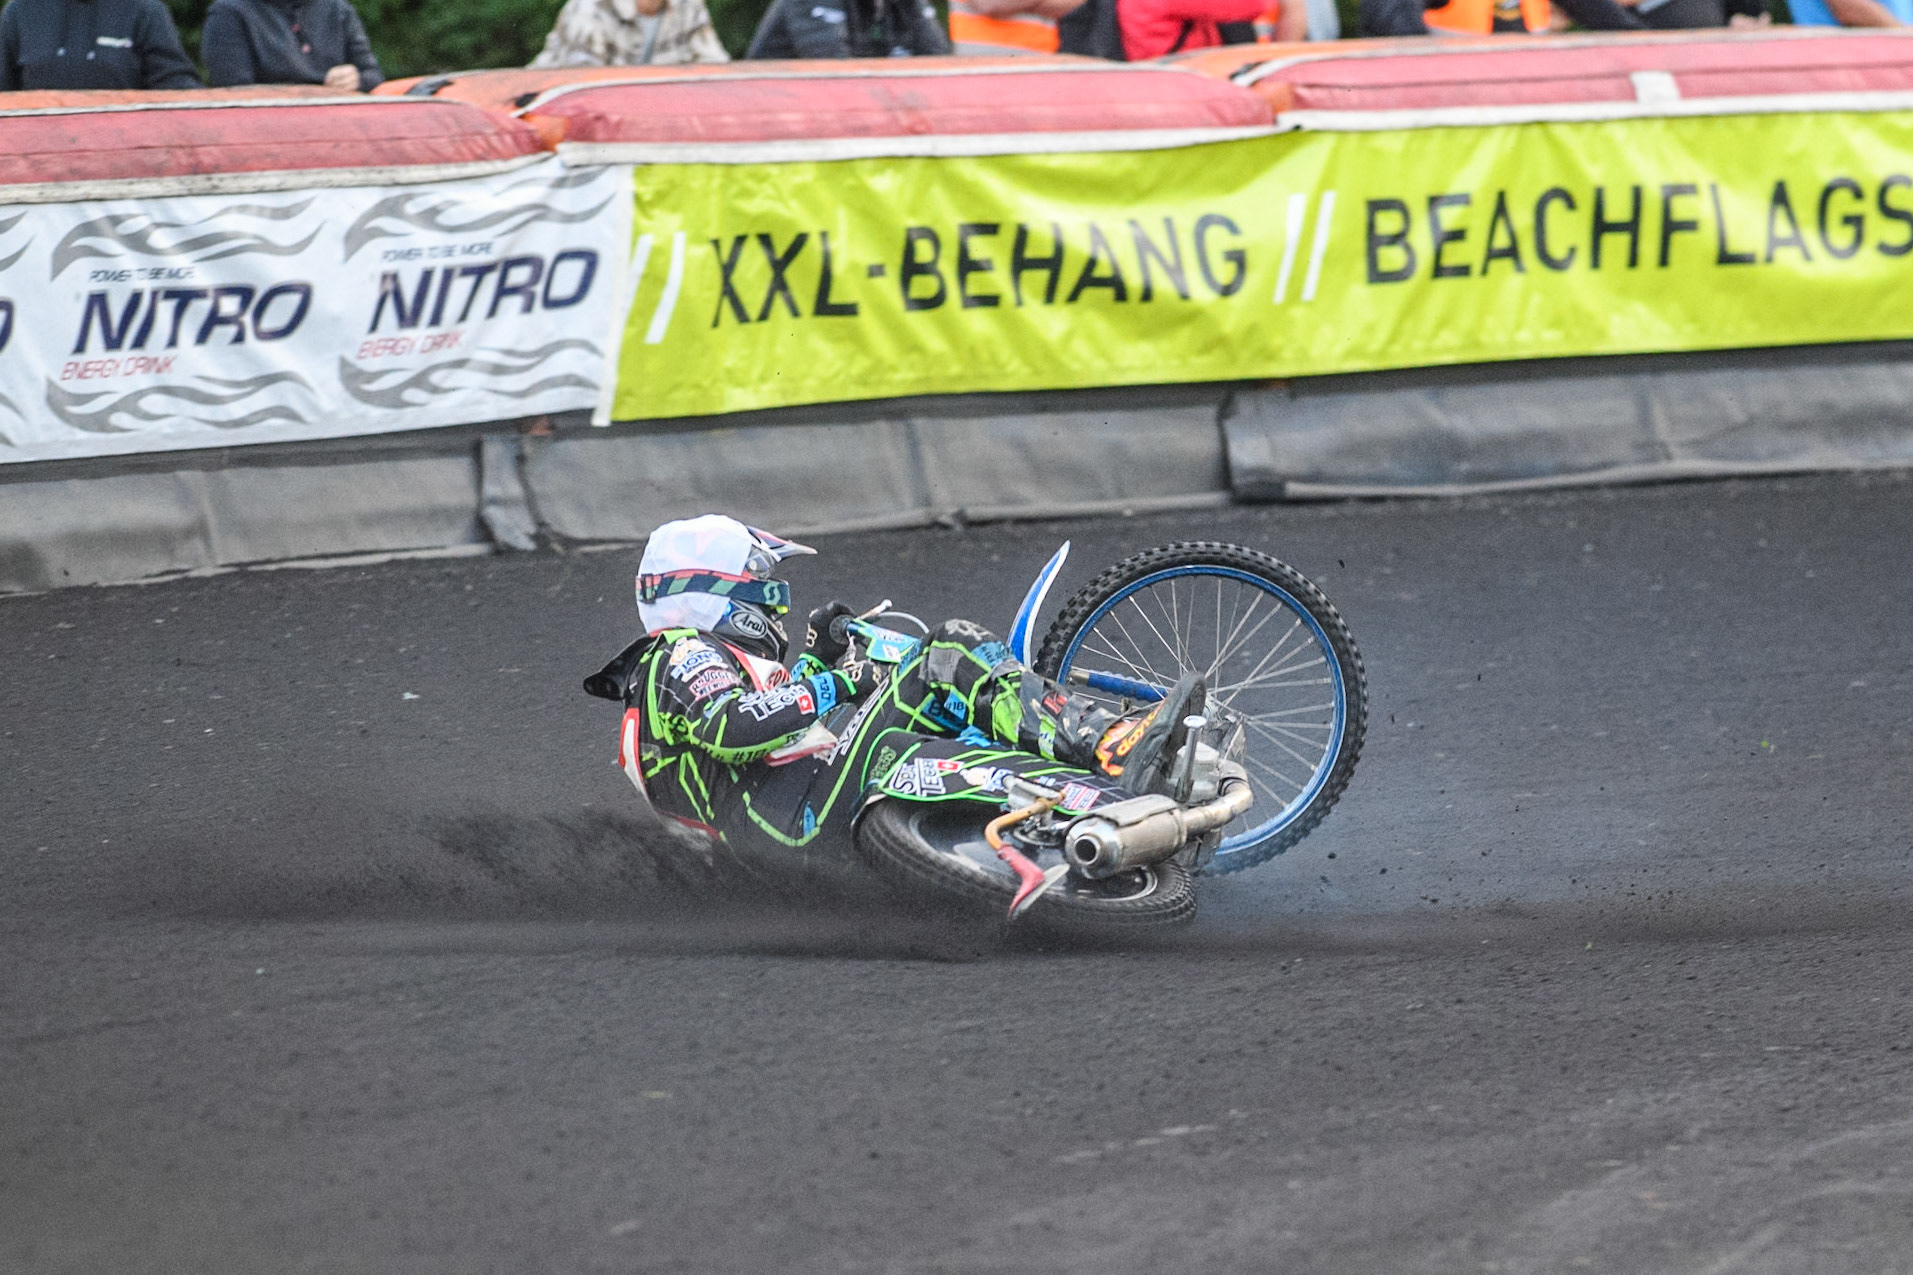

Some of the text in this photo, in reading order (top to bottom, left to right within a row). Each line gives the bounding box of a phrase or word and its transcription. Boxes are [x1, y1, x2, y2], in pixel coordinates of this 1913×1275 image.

[367, 247, 599, 335] NITRO
[710, 213, 1247, 329] XXL-BEHANG
[1364, 174, 1913, 285] BEACHFLAGS
[71, 280, 314, 356] NITRO
[738, 613, 764, 633] Arai
